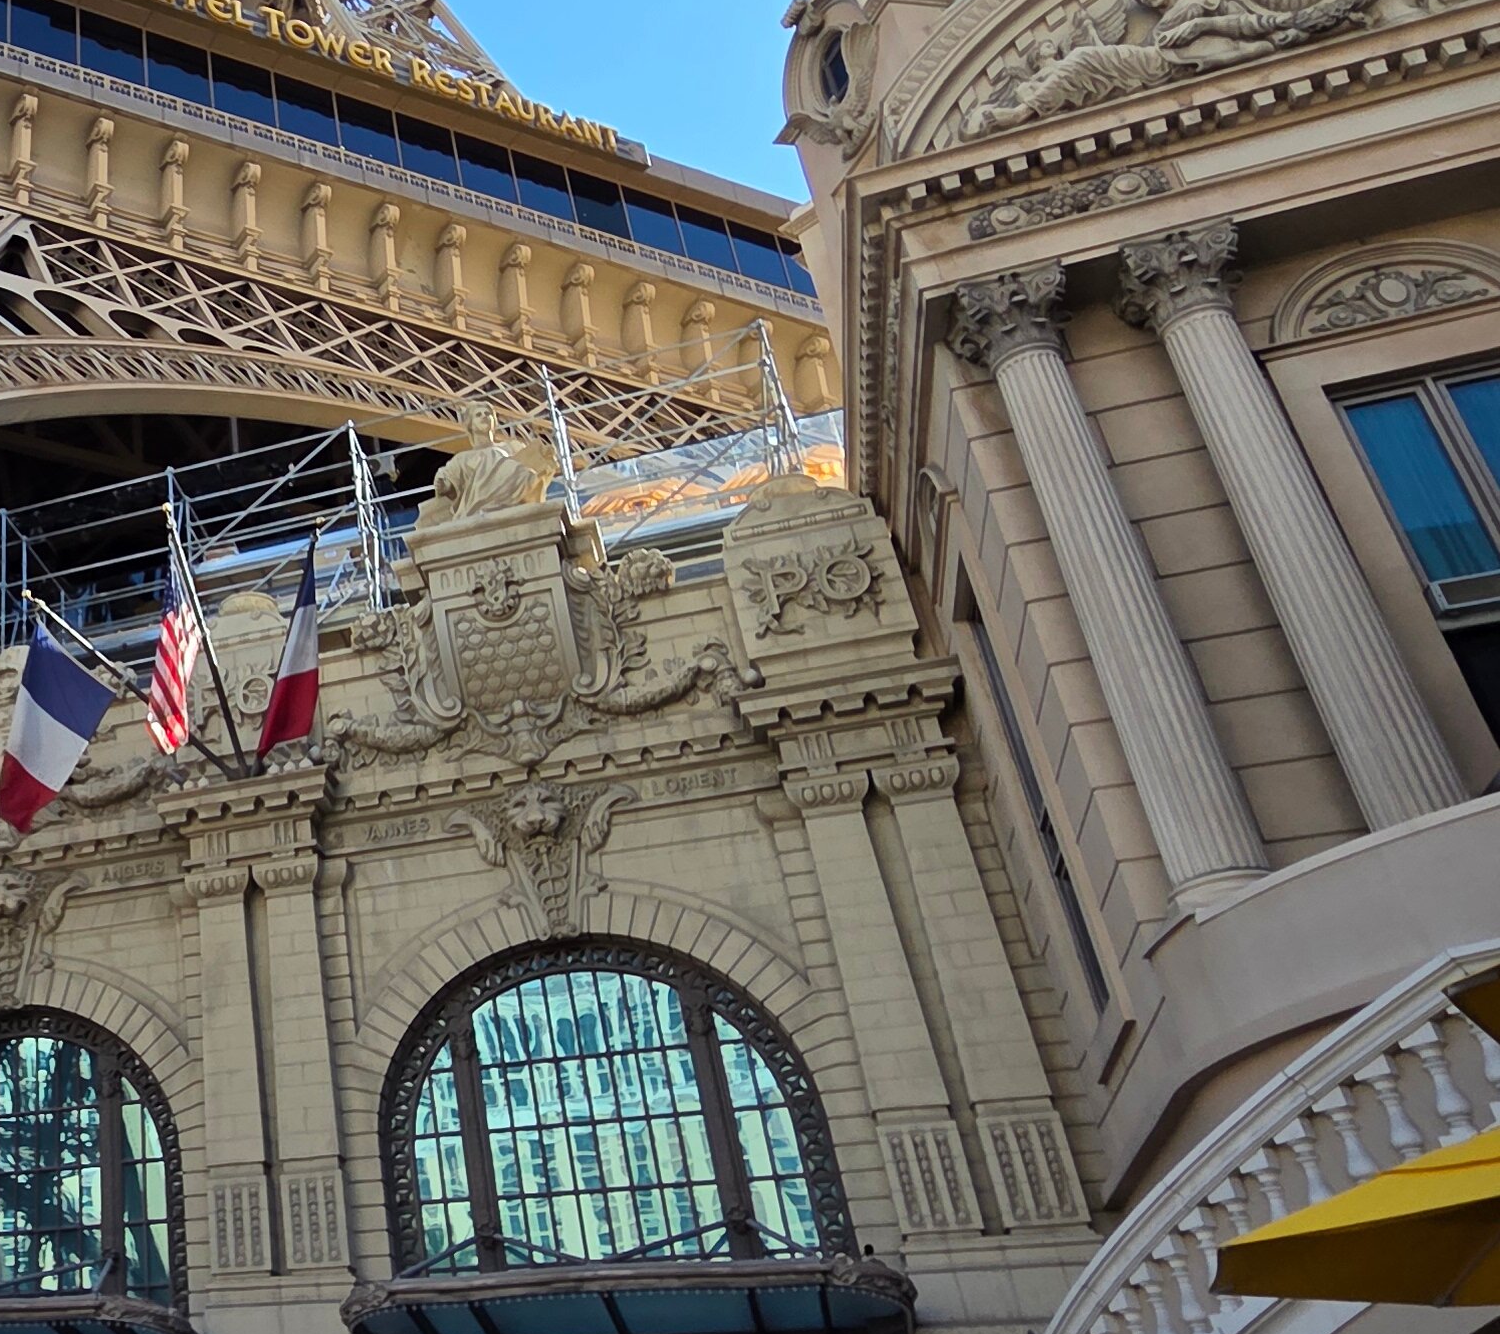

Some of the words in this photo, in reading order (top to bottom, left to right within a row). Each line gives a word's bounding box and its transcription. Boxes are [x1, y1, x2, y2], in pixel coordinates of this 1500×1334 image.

[259, 5, 397, 79] TOWER
[410, 56, 619, 153] RESTAURANT
[650, 767, 738, 798] LORIENT
